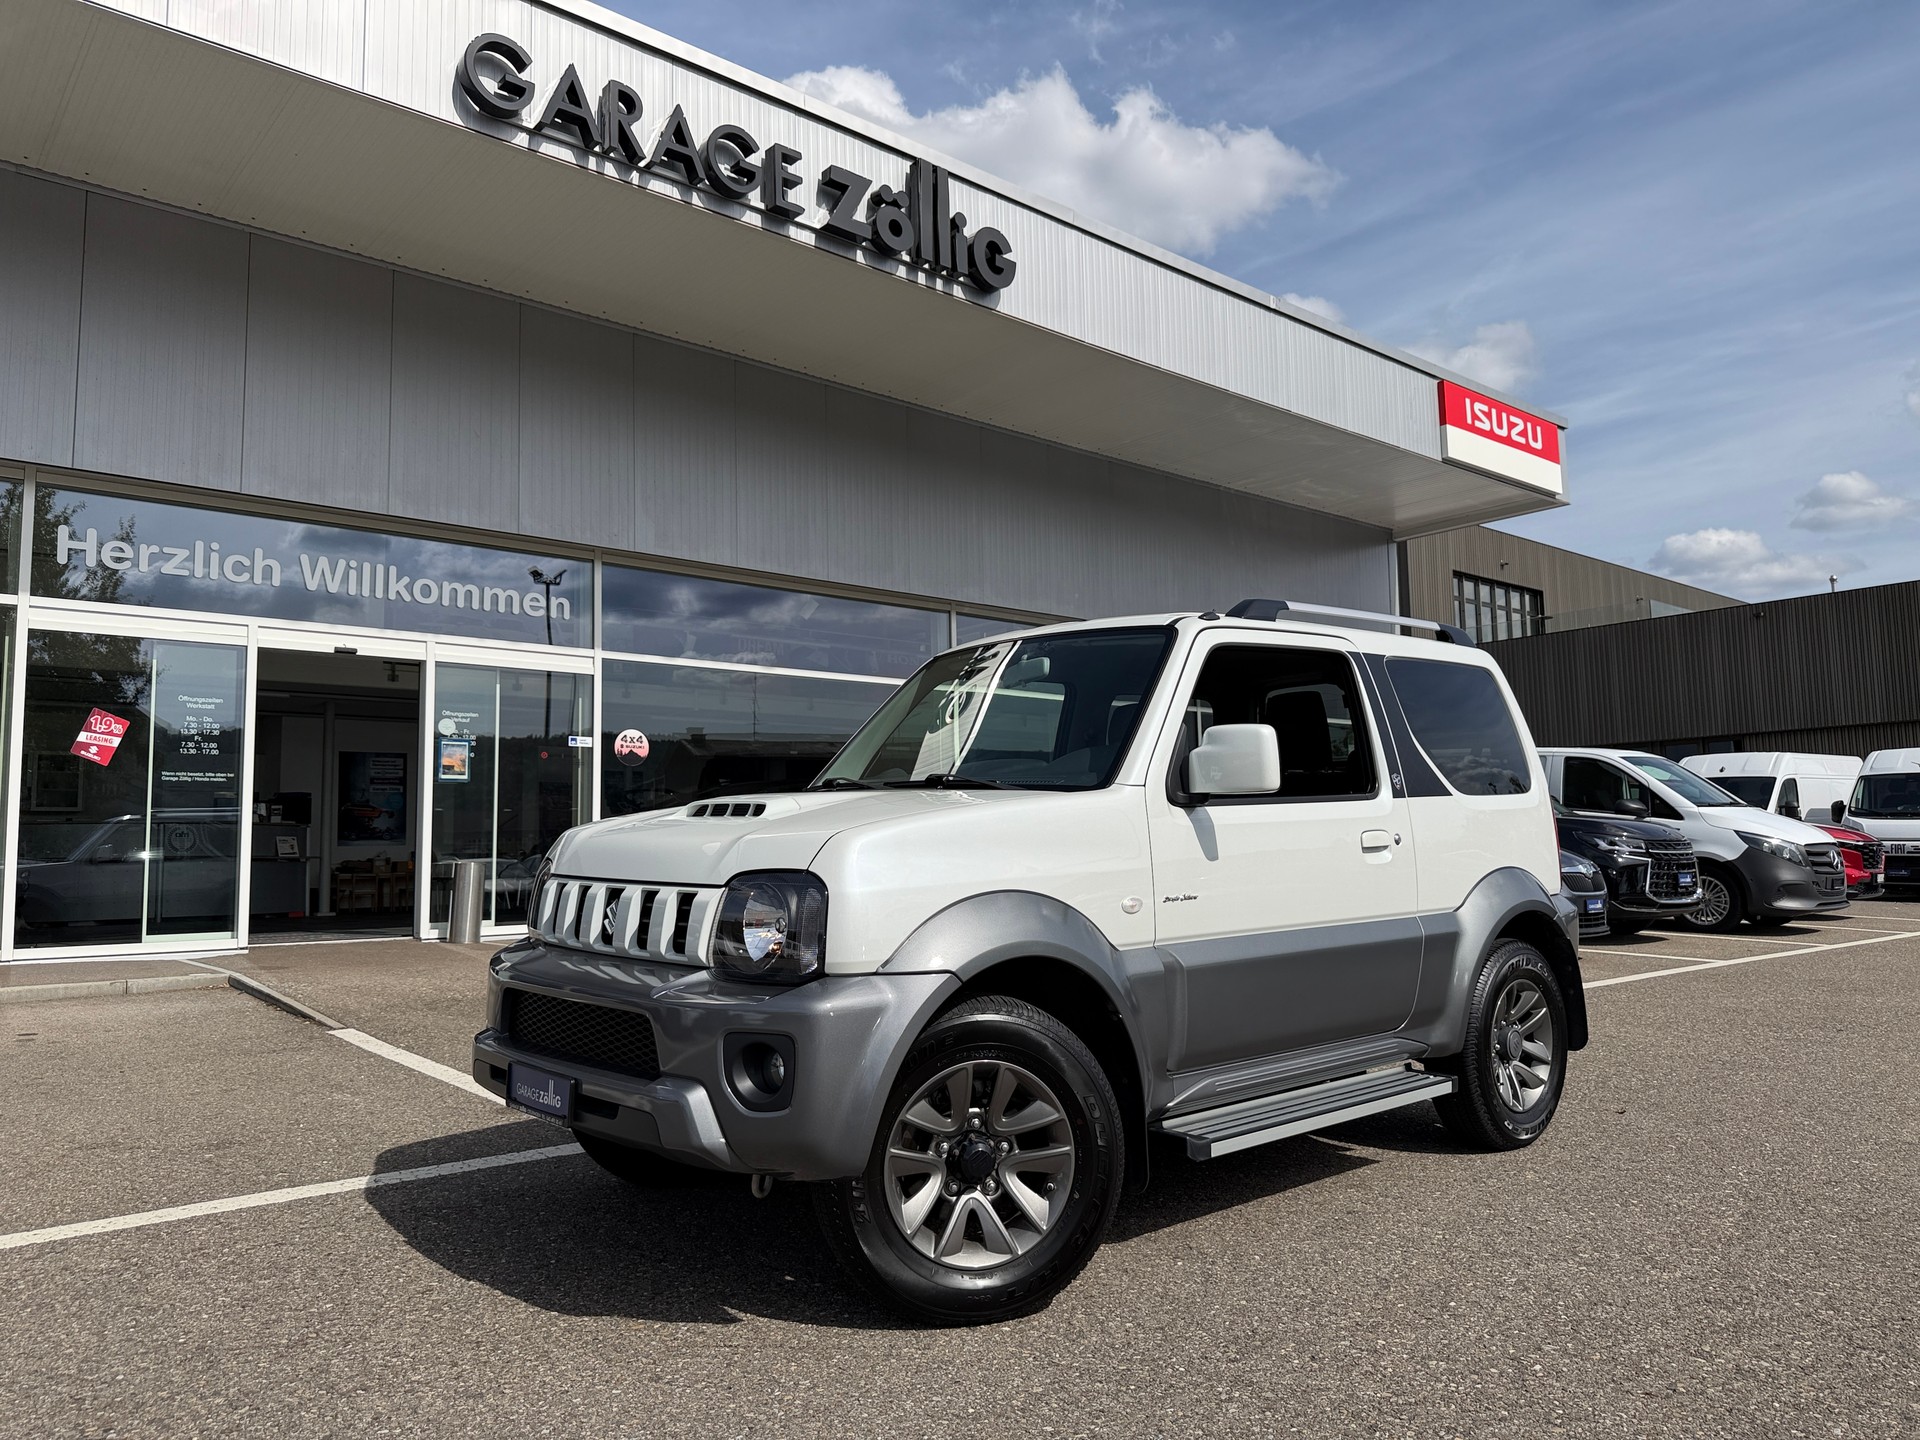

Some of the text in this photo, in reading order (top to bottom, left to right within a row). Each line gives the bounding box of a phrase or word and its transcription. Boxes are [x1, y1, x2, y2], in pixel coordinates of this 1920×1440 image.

[456, 33, 805, 219] GARAGE
[1465, 397, 1543, 450] ISUZU
[56, 524, 572, 621] Herzlich Willkommen
[86, 734, 114, 745] LEASING
[620, 734, 644, 744] 4x4
[1890, 843, 1906, 854] FIAT
